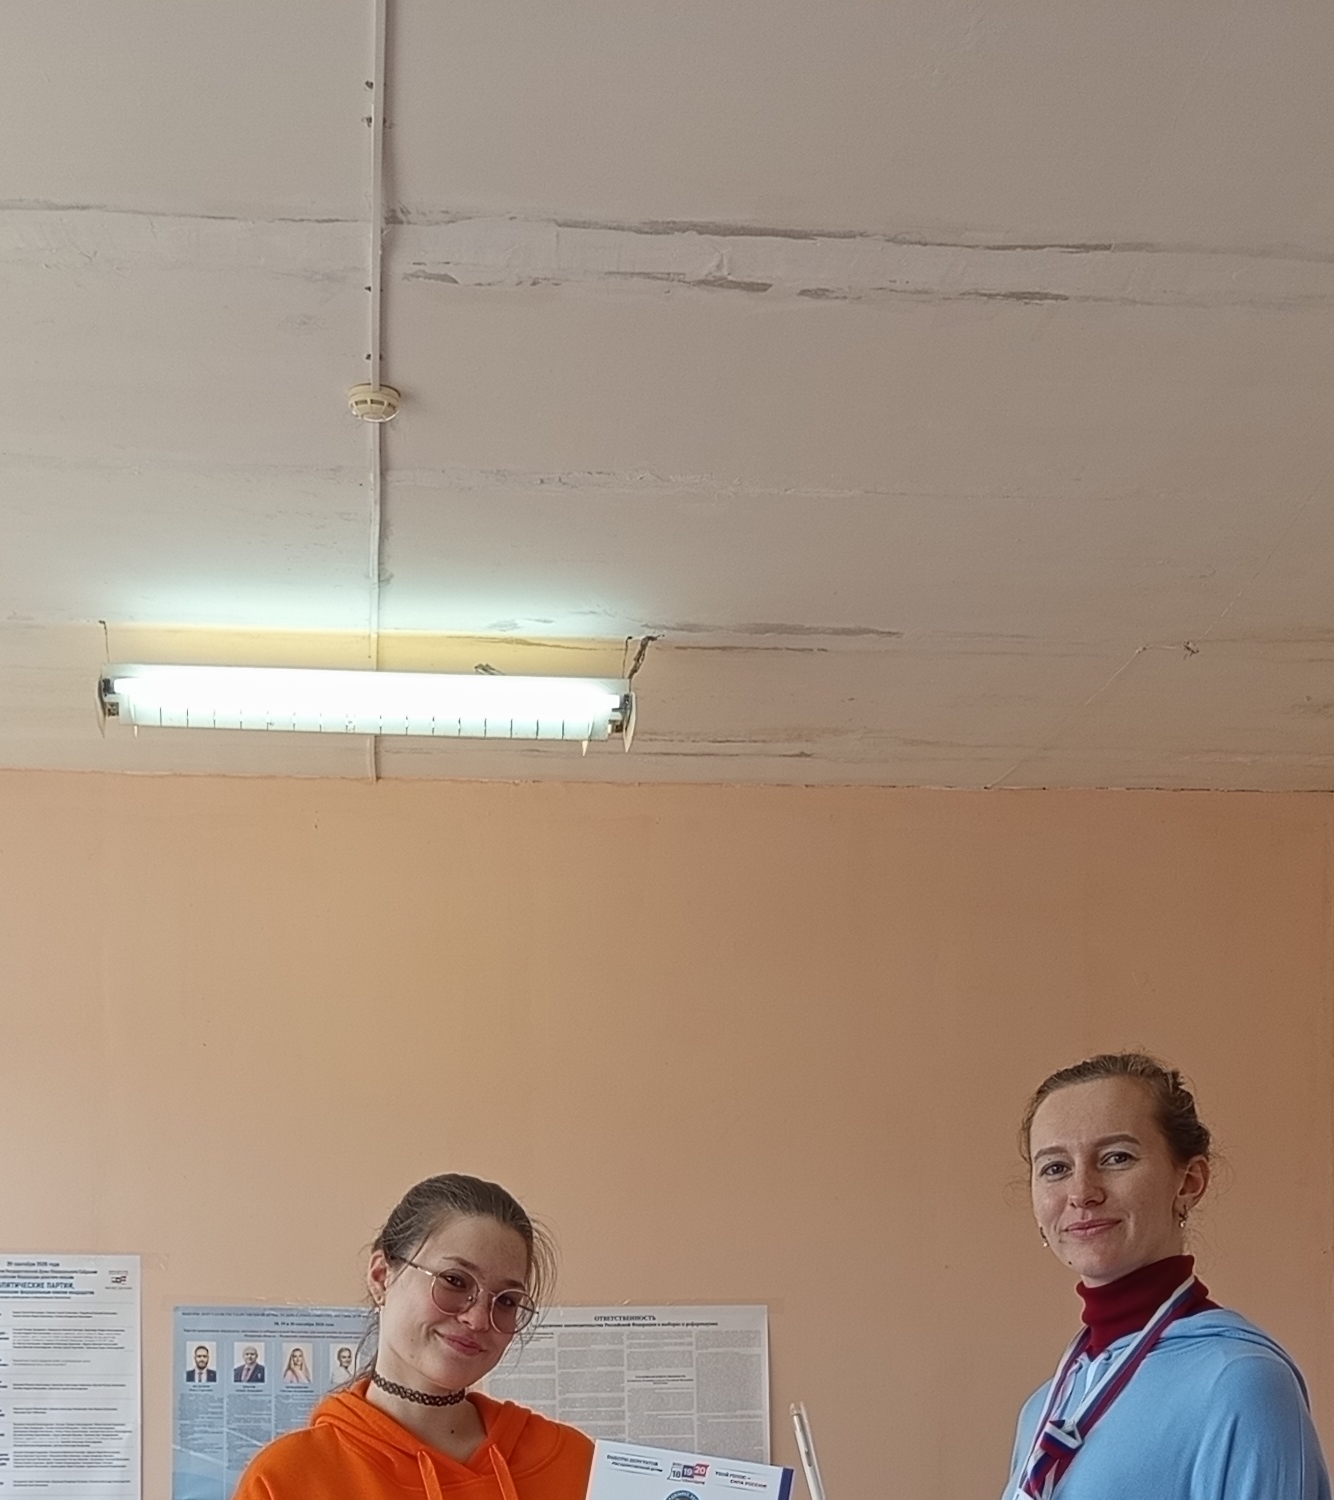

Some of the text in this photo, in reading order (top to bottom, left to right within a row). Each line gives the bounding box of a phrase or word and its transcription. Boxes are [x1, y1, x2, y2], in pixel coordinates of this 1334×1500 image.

[607, 1455, 658, 1466] ВЫБОРЫ ДЕПУТАТОВ
[672, 1466, 706, 1478] 18 19 20
